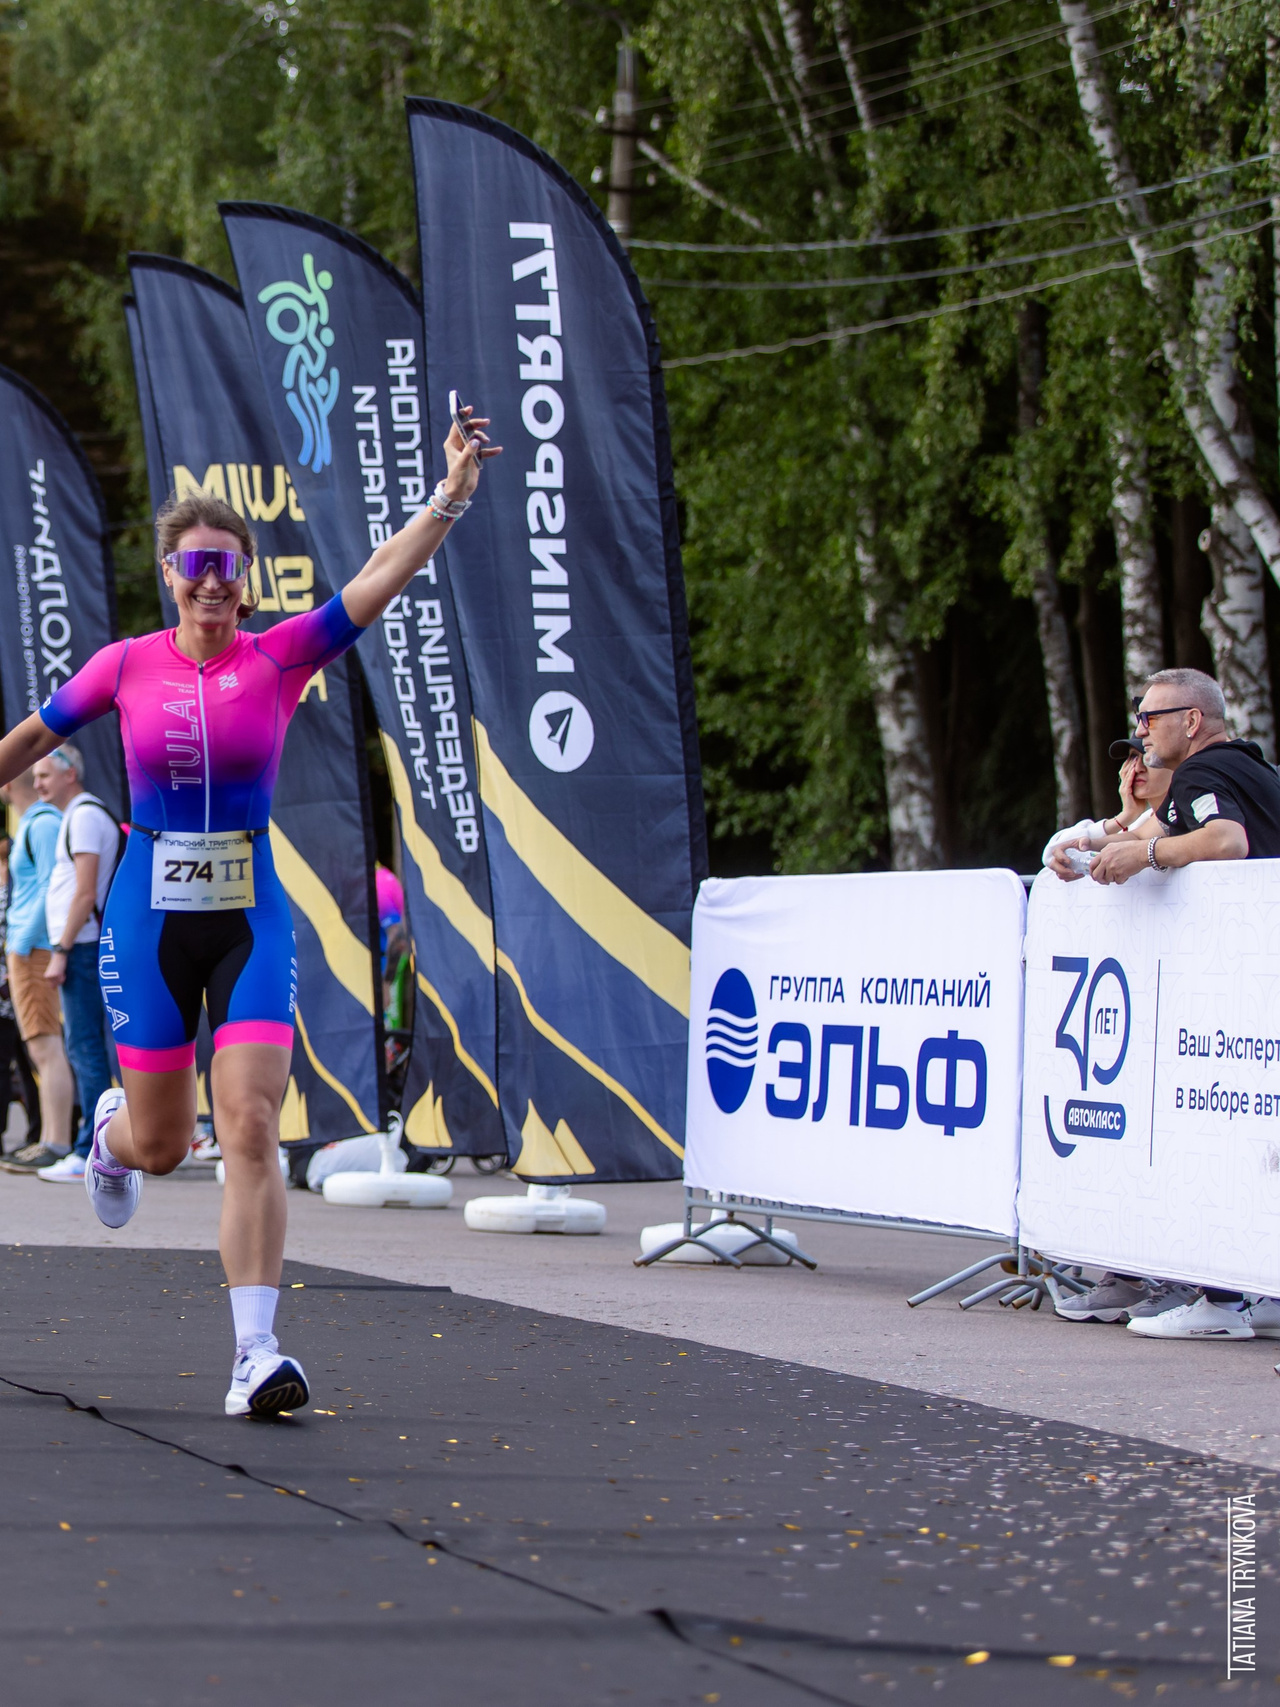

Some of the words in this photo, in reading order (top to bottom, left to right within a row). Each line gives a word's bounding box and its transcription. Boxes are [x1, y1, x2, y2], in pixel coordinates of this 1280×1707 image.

[162, 680, 195, 689] TRIATHLON
[163, 699, 202, 790] TULA
[164, 839, 206, 848] ТУЛЬСКИЙ
[164, 860, 214, 883] 274
[99, 927, 130, 1031] TULA
[769, 975, 845, 1003] ГРУППА
[860, 972, 991, 1009] КОМПАНИЙ
[1095, 1007, 1119, 1035] ЛЕТ
[1178, 1028, 1211, 1057] Ваш
[765, 1021, 987, 1137] ЭЛЬФ
[1176, 1087, 1184, 1109] в
[1188, 1081, 1249, 1120] выборе
[1068, 1107, 1122, 1131] АВТОКЛАСС
